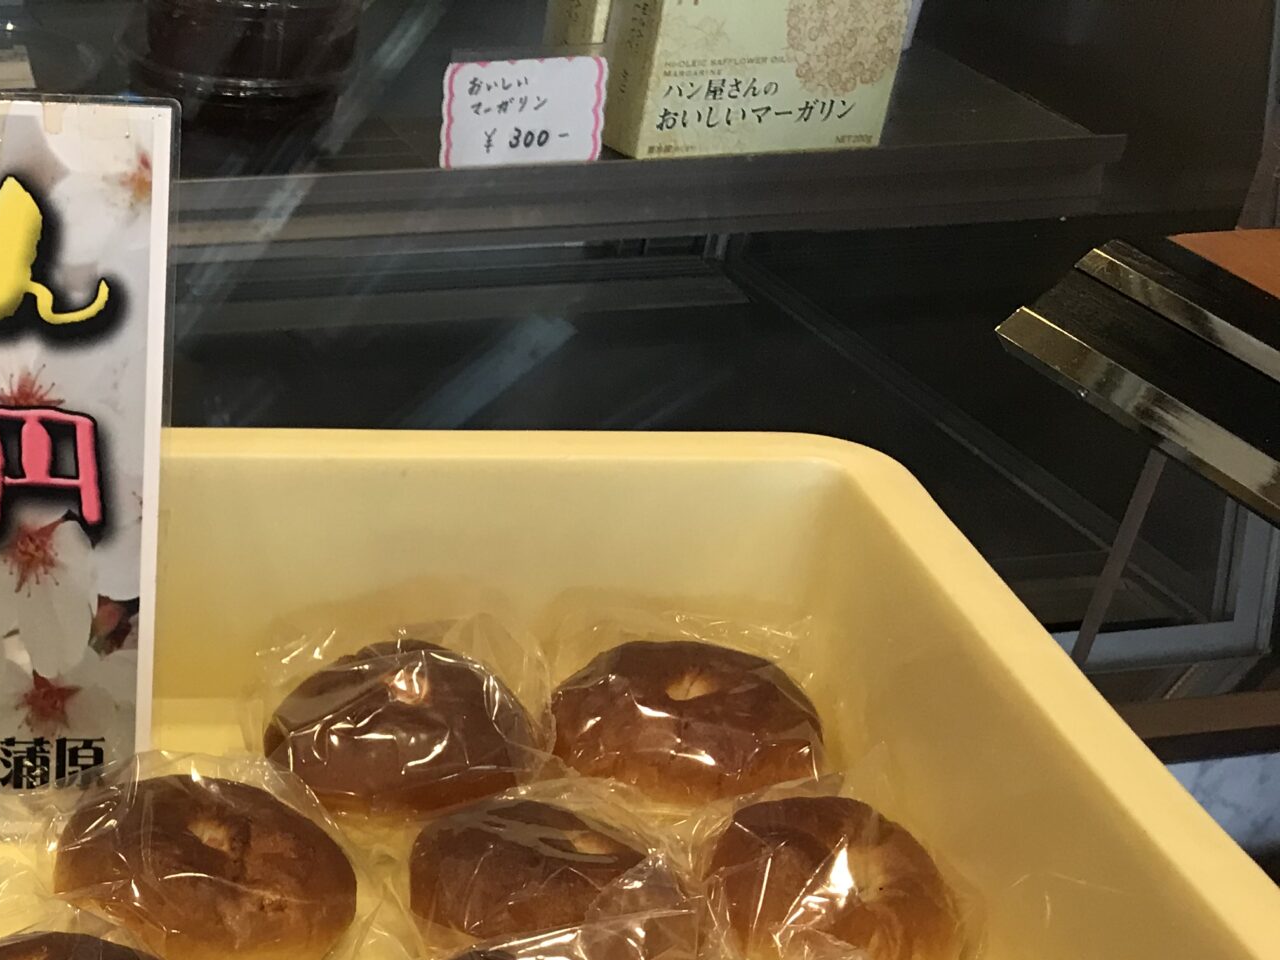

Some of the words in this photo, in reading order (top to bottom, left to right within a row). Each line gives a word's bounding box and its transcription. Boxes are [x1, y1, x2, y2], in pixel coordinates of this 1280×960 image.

[467, 76, 529, 95] おいしい
[663, 78, 779, 101] パン屋さんの
[470, 96, 548, 116] マーガリン
[655, 99, 856, 132] おいしいマーガリン
